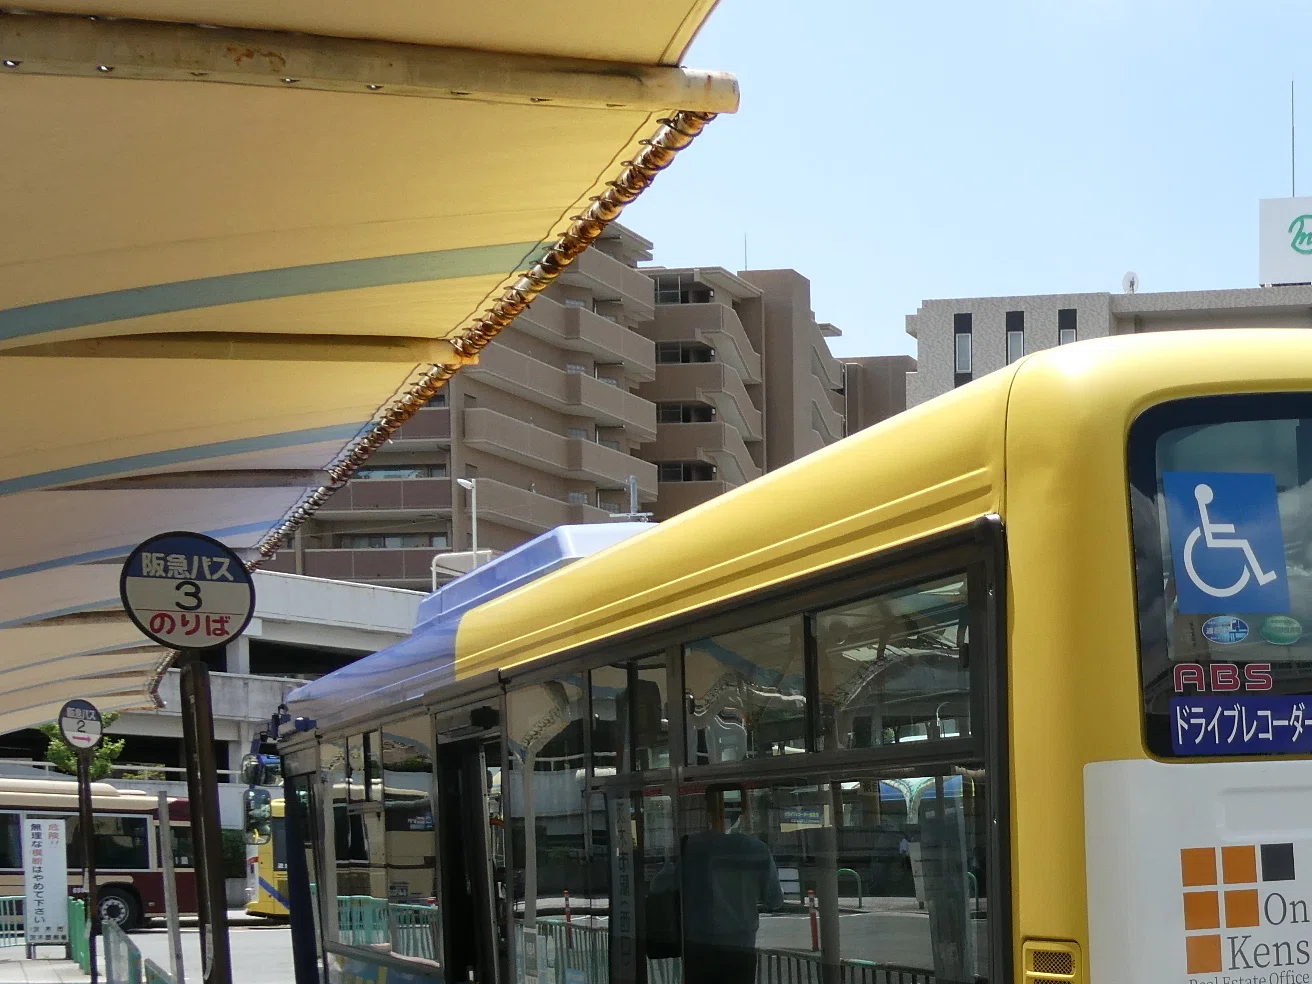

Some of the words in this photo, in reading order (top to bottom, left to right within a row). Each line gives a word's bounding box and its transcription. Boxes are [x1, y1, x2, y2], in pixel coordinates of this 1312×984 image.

[141, 552, 234, 580] 阪急バス
[175, 580, 203, 611] 3
[149, 612, 231, 637] のりば
[1173, 663, 1273, 692] ABS
[66, 707, 97, 720] 阪急バス
[77, 719, 86, 733] 2
[31, 823, 45, 924] 無理な横断はやめて下さい
